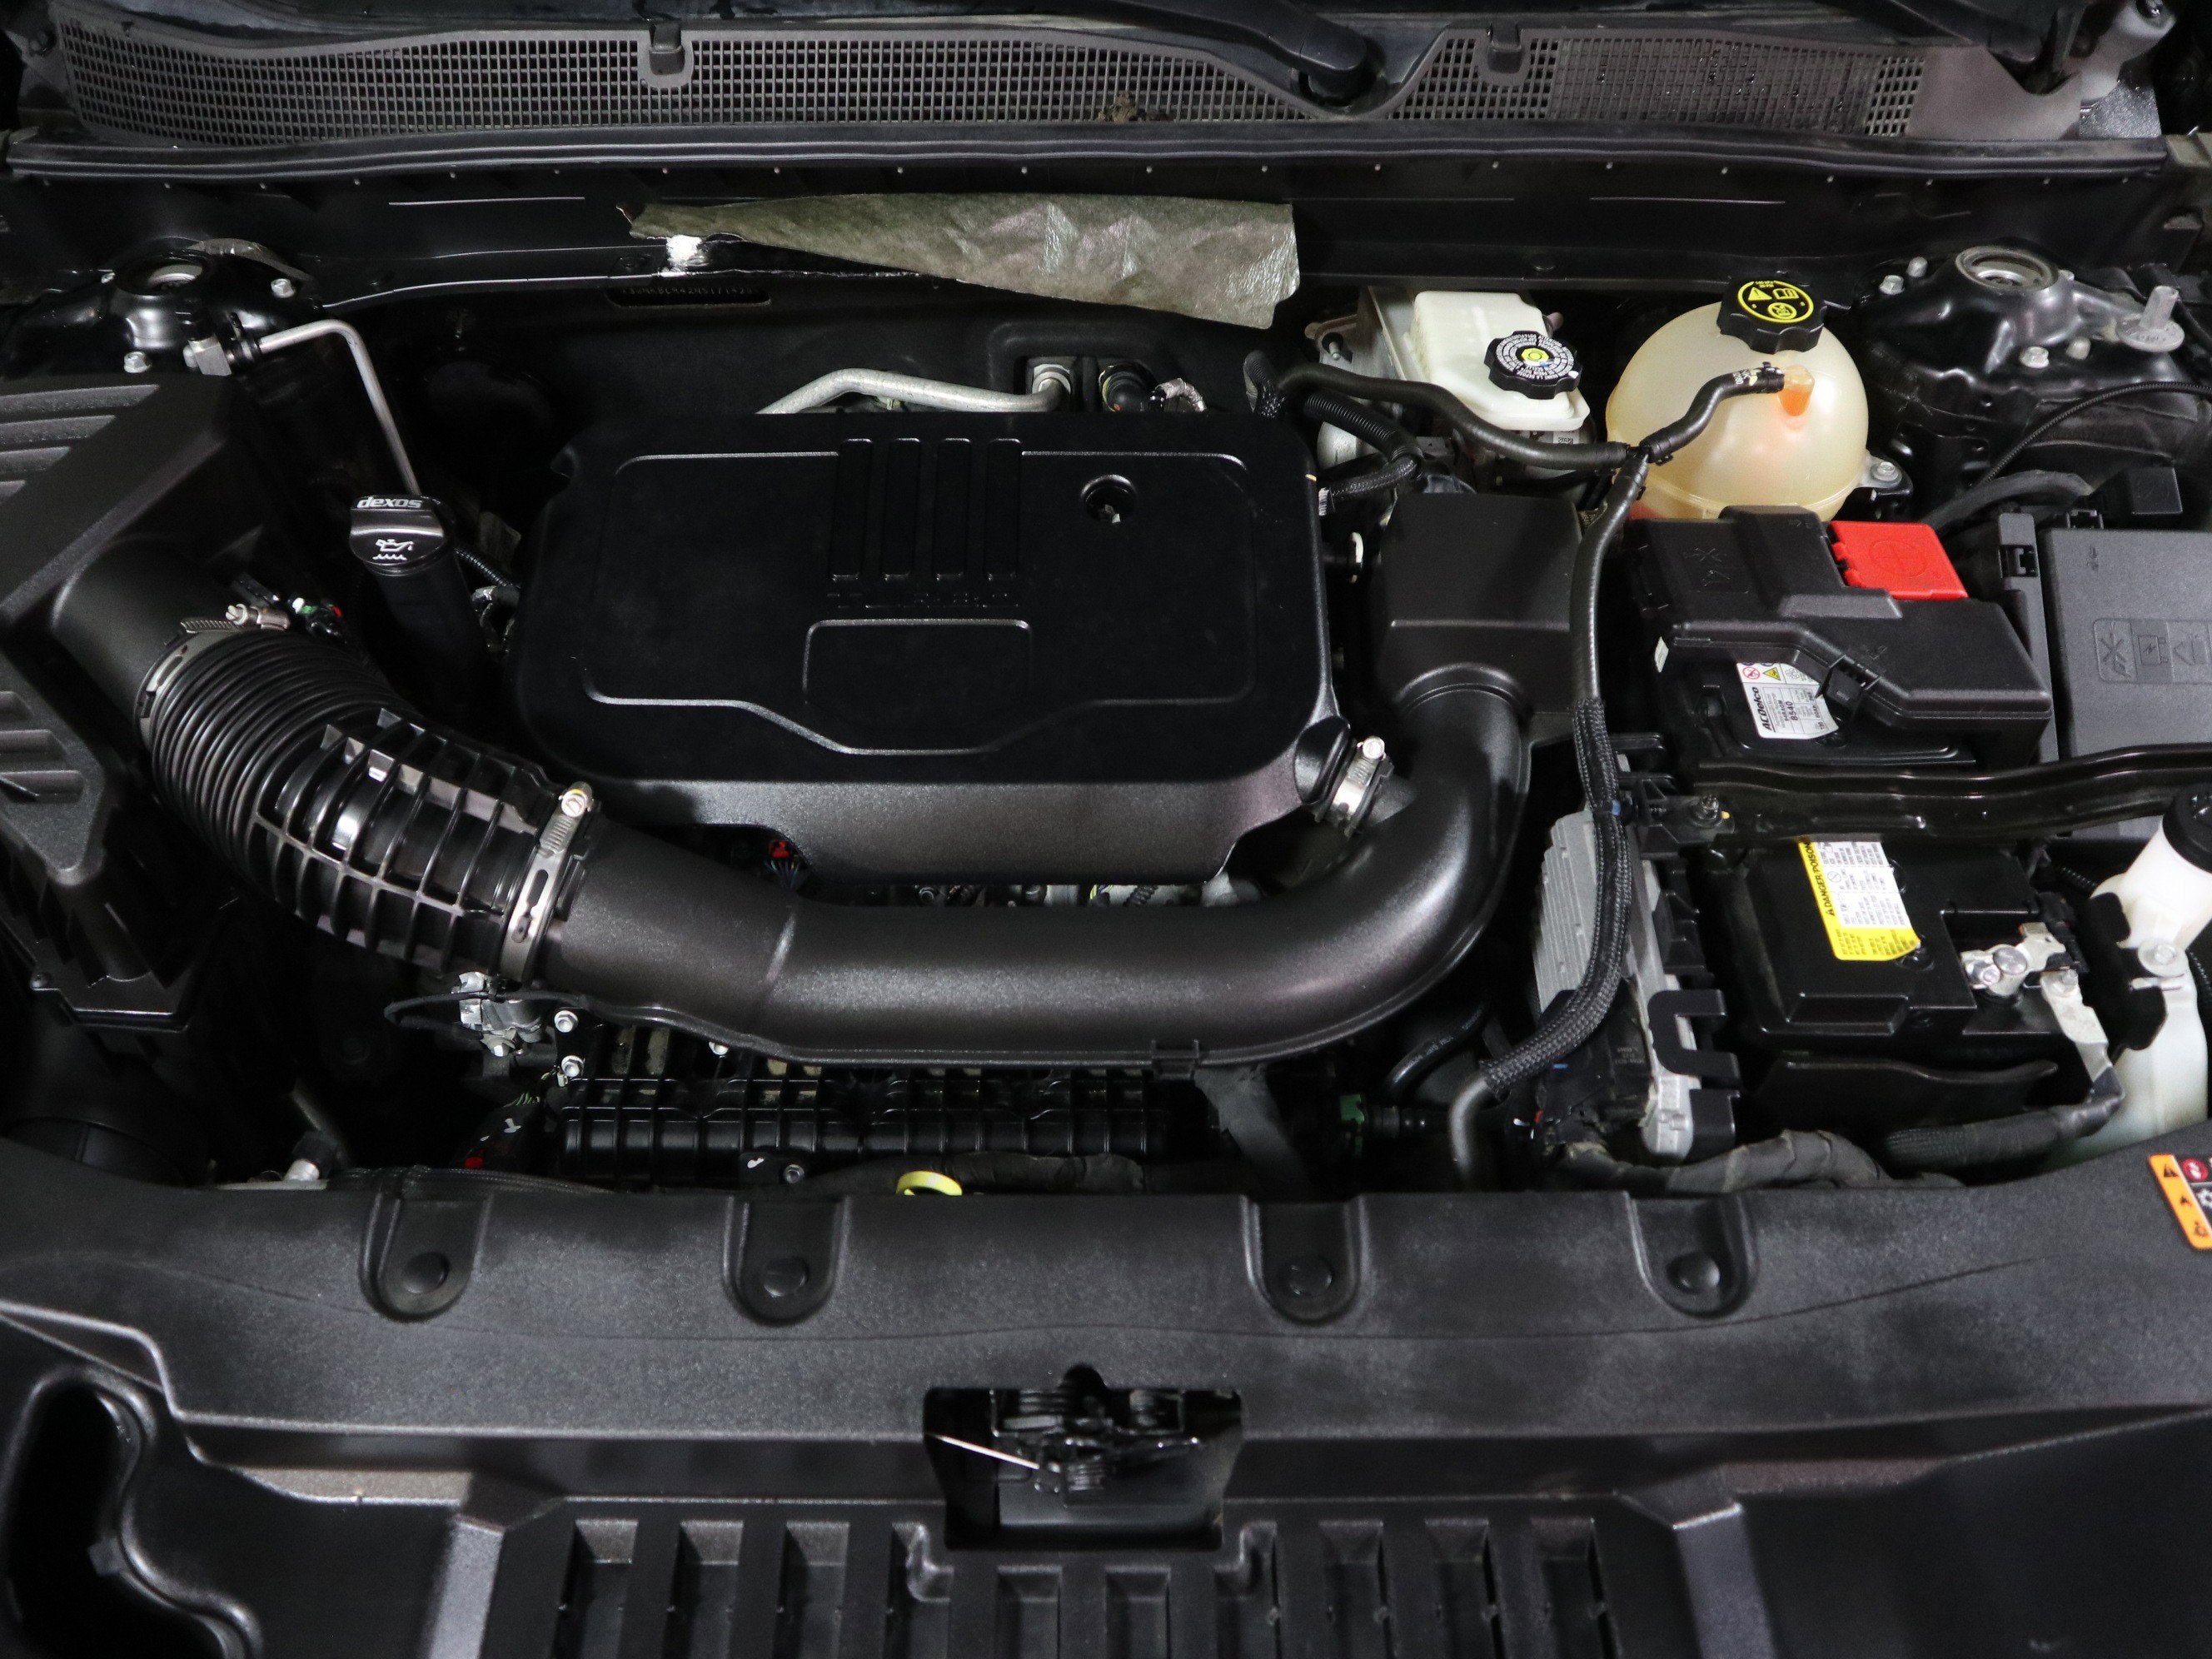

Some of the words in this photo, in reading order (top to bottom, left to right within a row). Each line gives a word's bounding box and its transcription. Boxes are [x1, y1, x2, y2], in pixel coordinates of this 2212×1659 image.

[356, 496, 422, 509] dexos
[1752, 686, 1772, 731] ACDelco
[1786, 701, 1799, 721] 8540
